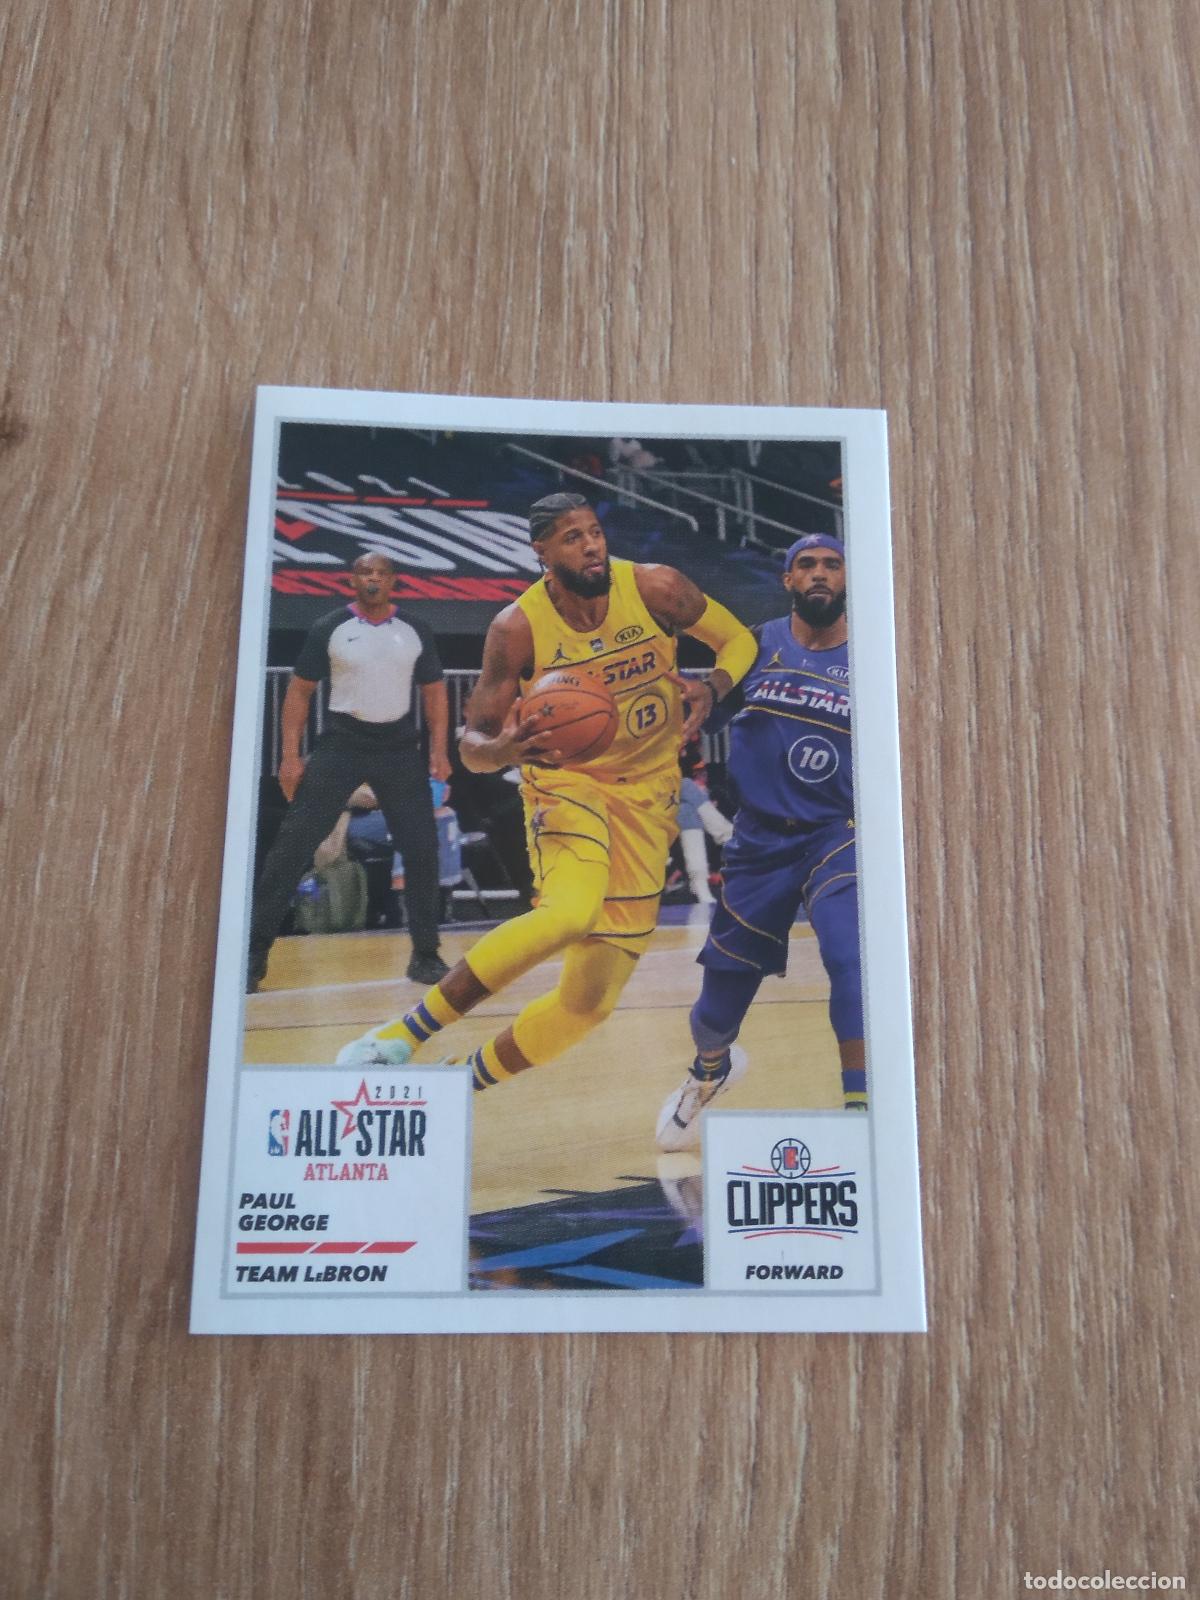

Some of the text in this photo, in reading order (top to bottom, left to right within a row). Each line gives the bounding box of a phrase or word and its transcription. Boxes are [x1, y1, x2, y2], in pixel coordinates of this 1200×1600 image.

[620, 628, 639, 642] KIA
[603, 651, 656, 686] STAR
[635, 703, 657, 730] 13
[799, 746, 830, 771] 10
[375, 1086, 422, 1099] 2021
[295, 1109, 427, 1157] ALL STAR
[303, 1163, 389, 1181] ATLANTA
[238, 1193, 296, 1209] PAUL
[727, 1180, 859, 1227] CLIPPERS
[238, 1215, 330, 1231] GEORGE
[236, 1266, 299, 1282] TEAM
[745, 1265, 844, 1280] FORWARD
